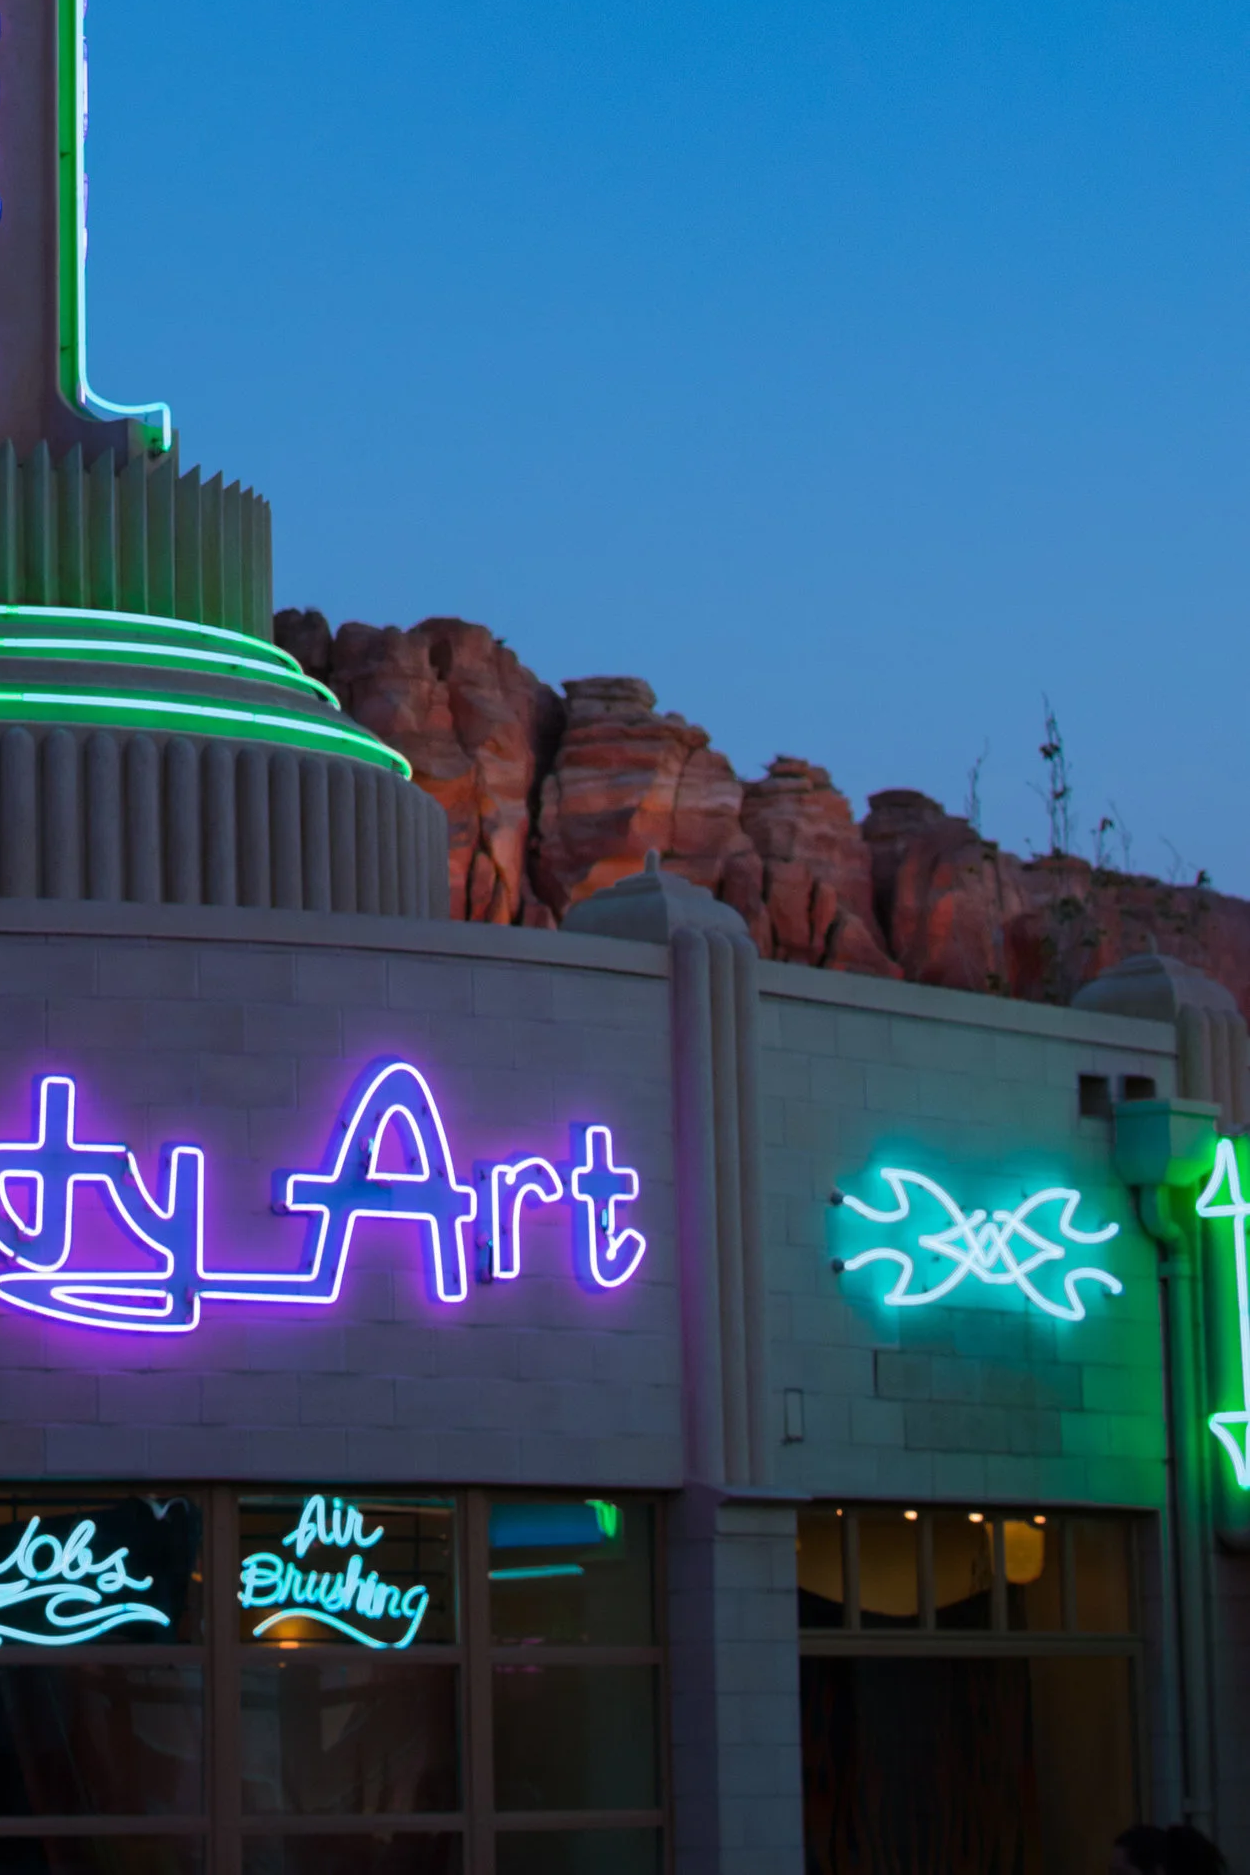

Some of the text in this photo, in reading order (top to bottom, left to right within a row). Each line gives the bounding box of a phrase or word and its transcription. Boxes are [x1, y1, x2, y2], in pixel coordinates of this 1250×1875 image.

[284, 1062, 646, 1303] Art
[282, 1494, 384, 1558] Air
[237, 1552, 429, 1623] Brushing
